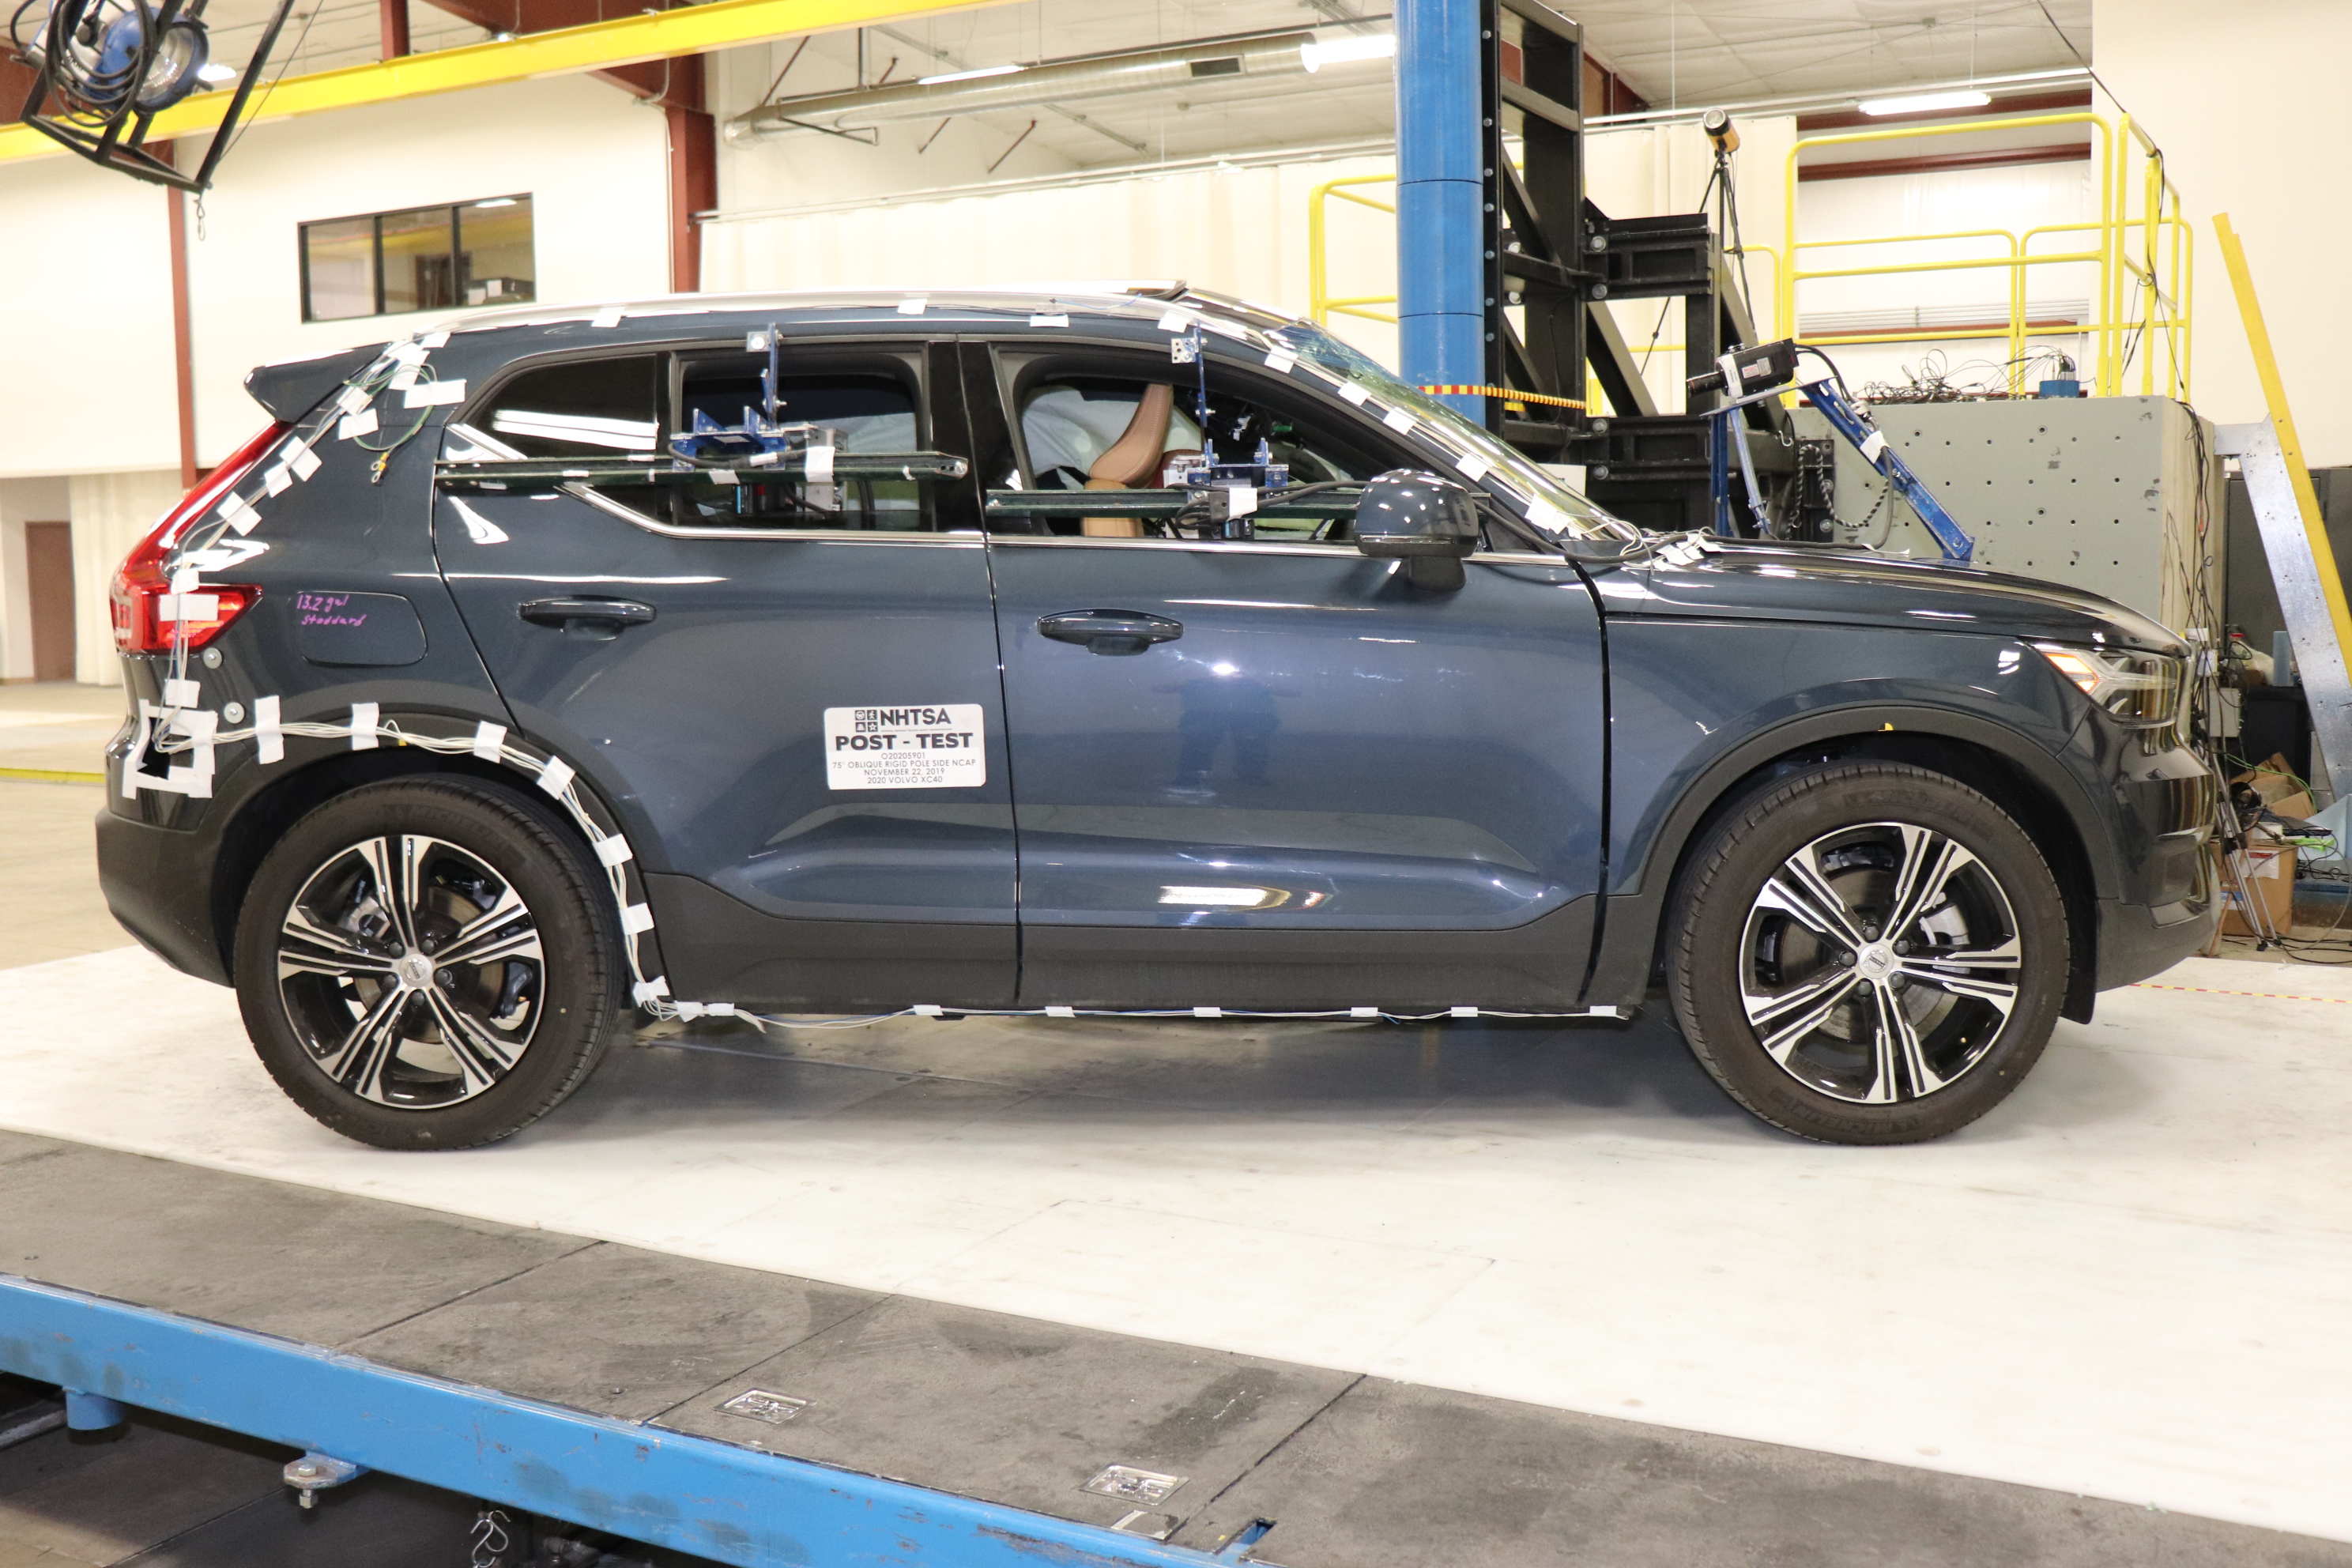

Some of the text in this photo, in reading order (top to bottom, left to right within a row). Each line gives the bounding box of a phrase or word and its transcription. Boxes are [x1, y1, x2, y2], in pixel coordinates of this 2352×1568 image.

[296, 594, 323, 612] 13.2
[880, 708, 952, 726] NHTSA
[835, 734, 897, 751] POST
[916, 733, 973, 749] TEST
